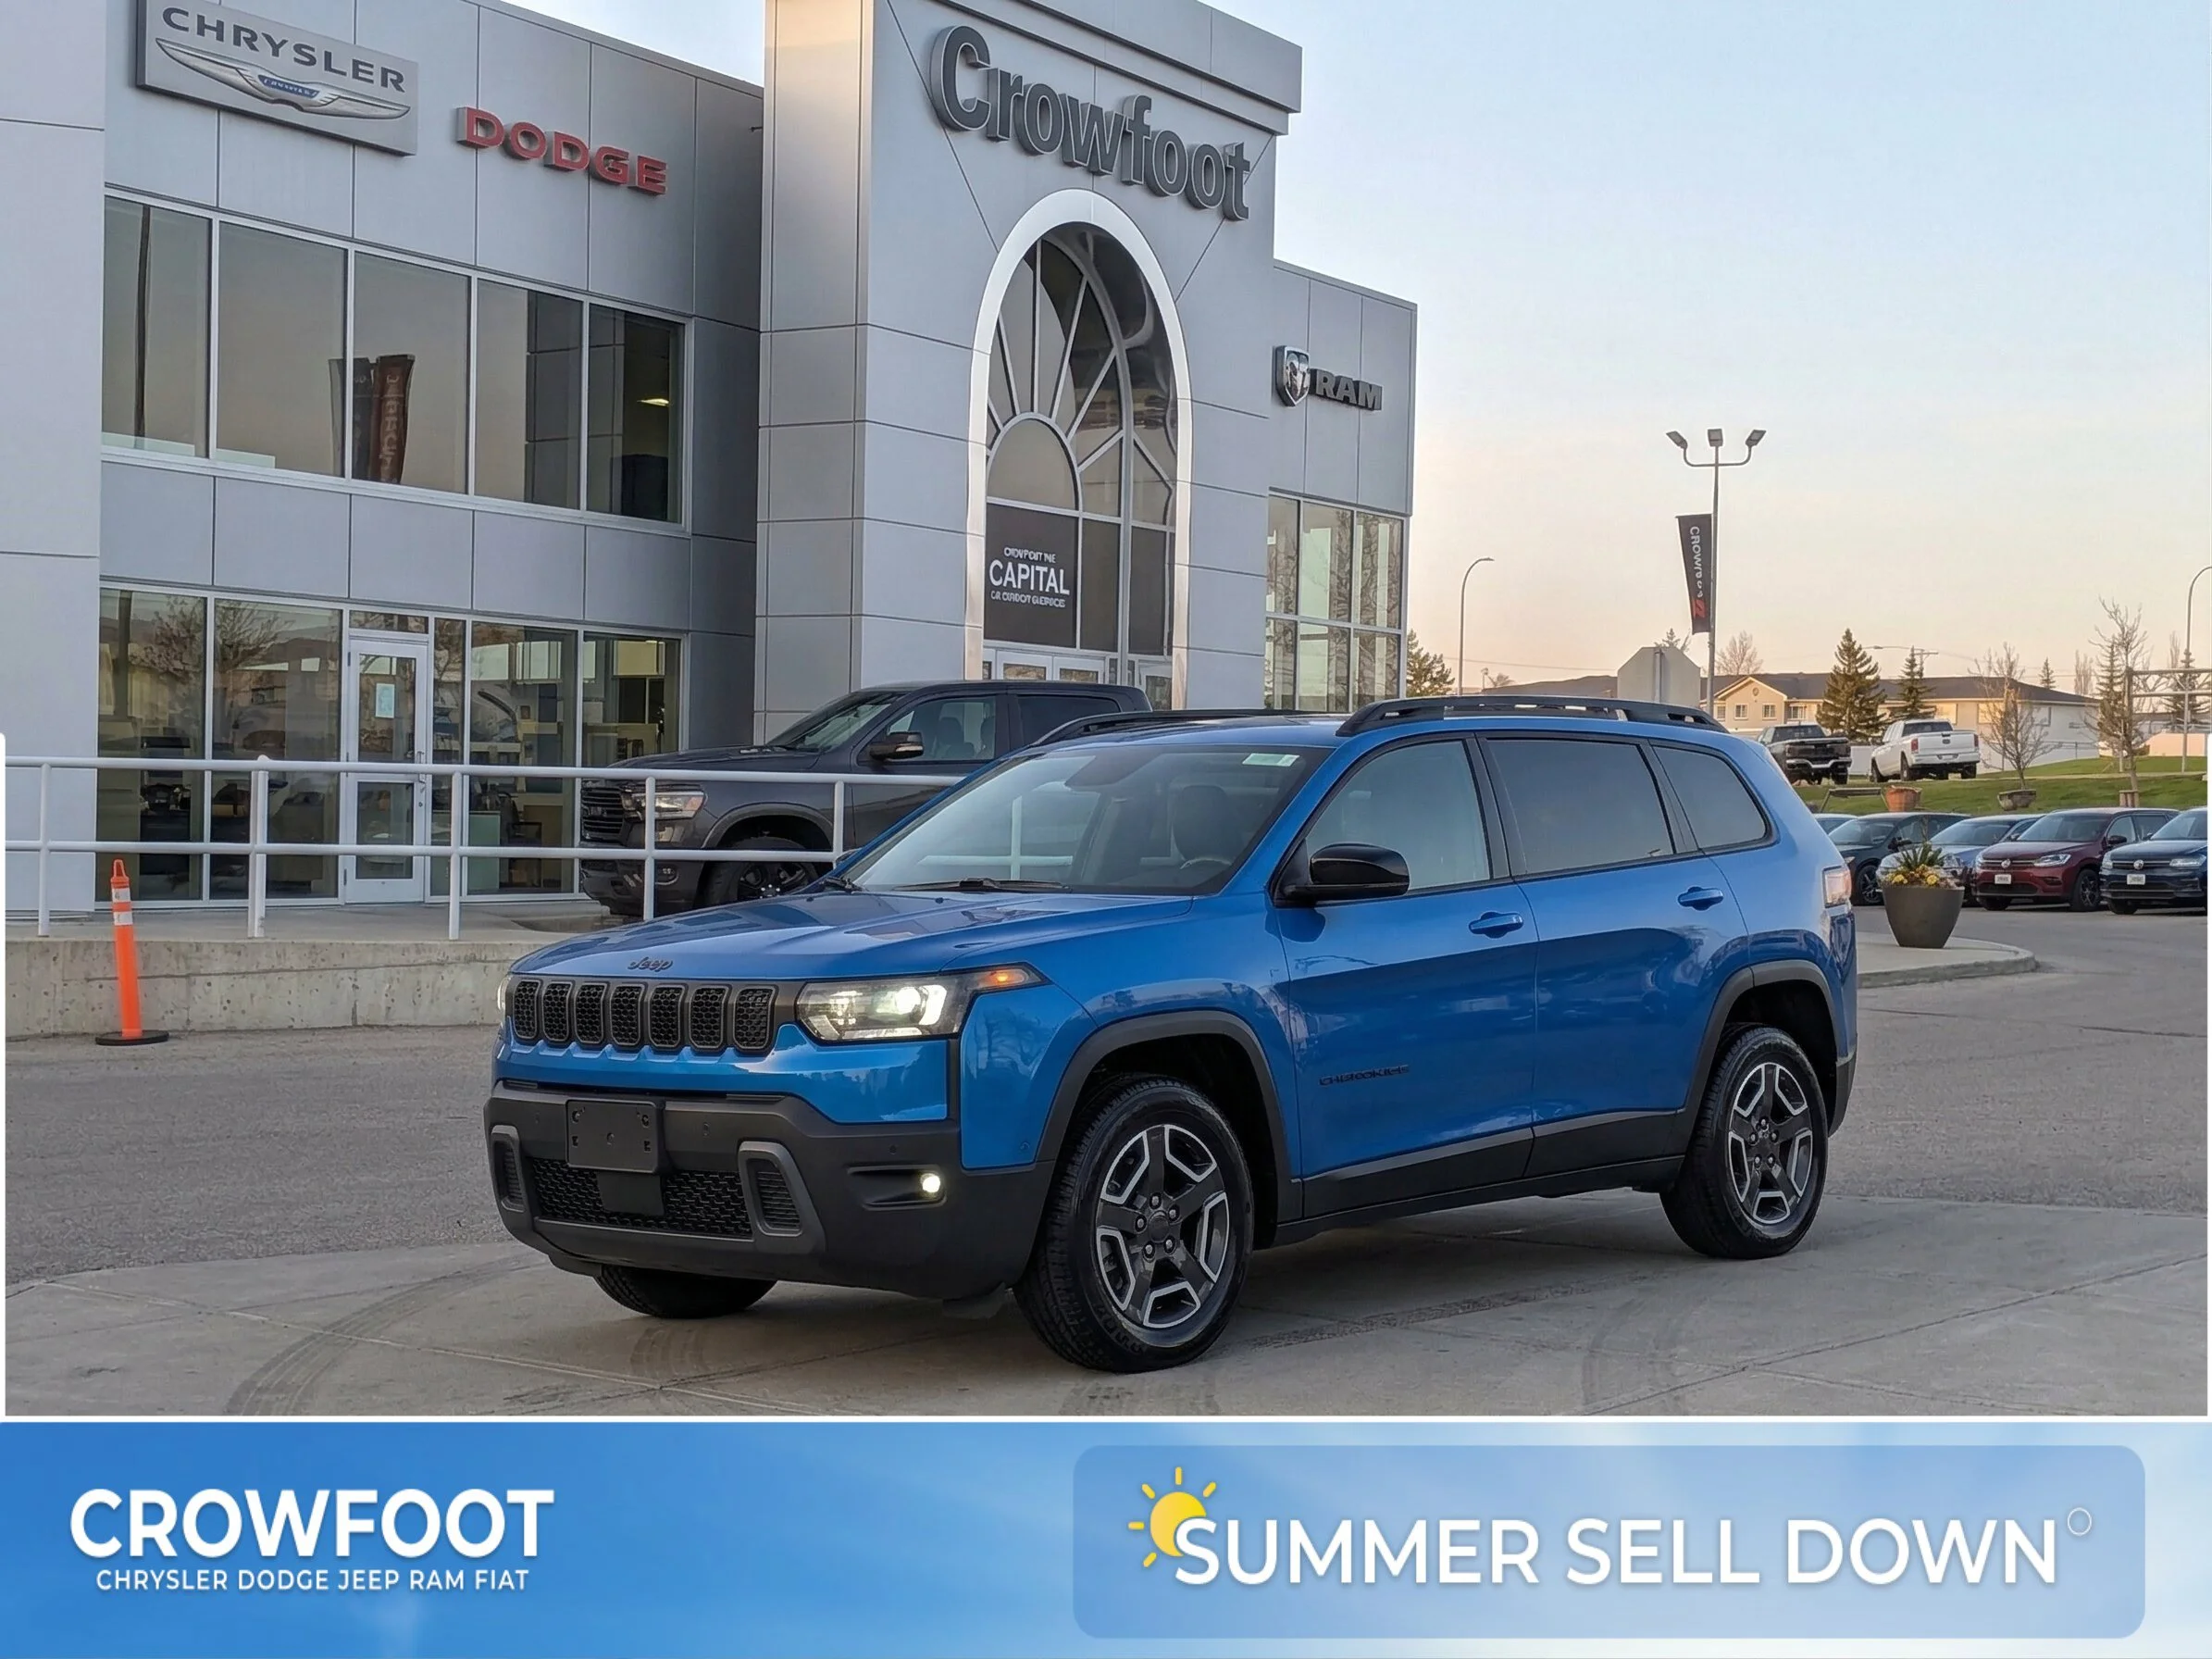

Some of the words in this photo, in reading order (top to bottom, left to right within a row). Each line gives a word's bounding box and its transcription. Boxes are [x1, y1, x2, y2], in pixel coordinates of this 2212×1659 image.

[162, 6, 405, 93] CHRYSLER
[456, 106, 667, 195] DODGE
[929, 25, 1250, 221] Crowfoot
[1309, 368, 1383, 411] RAM
[988, 559, 1071, 595] CAPITAL
[627, 956, 674, 973] Jeep
